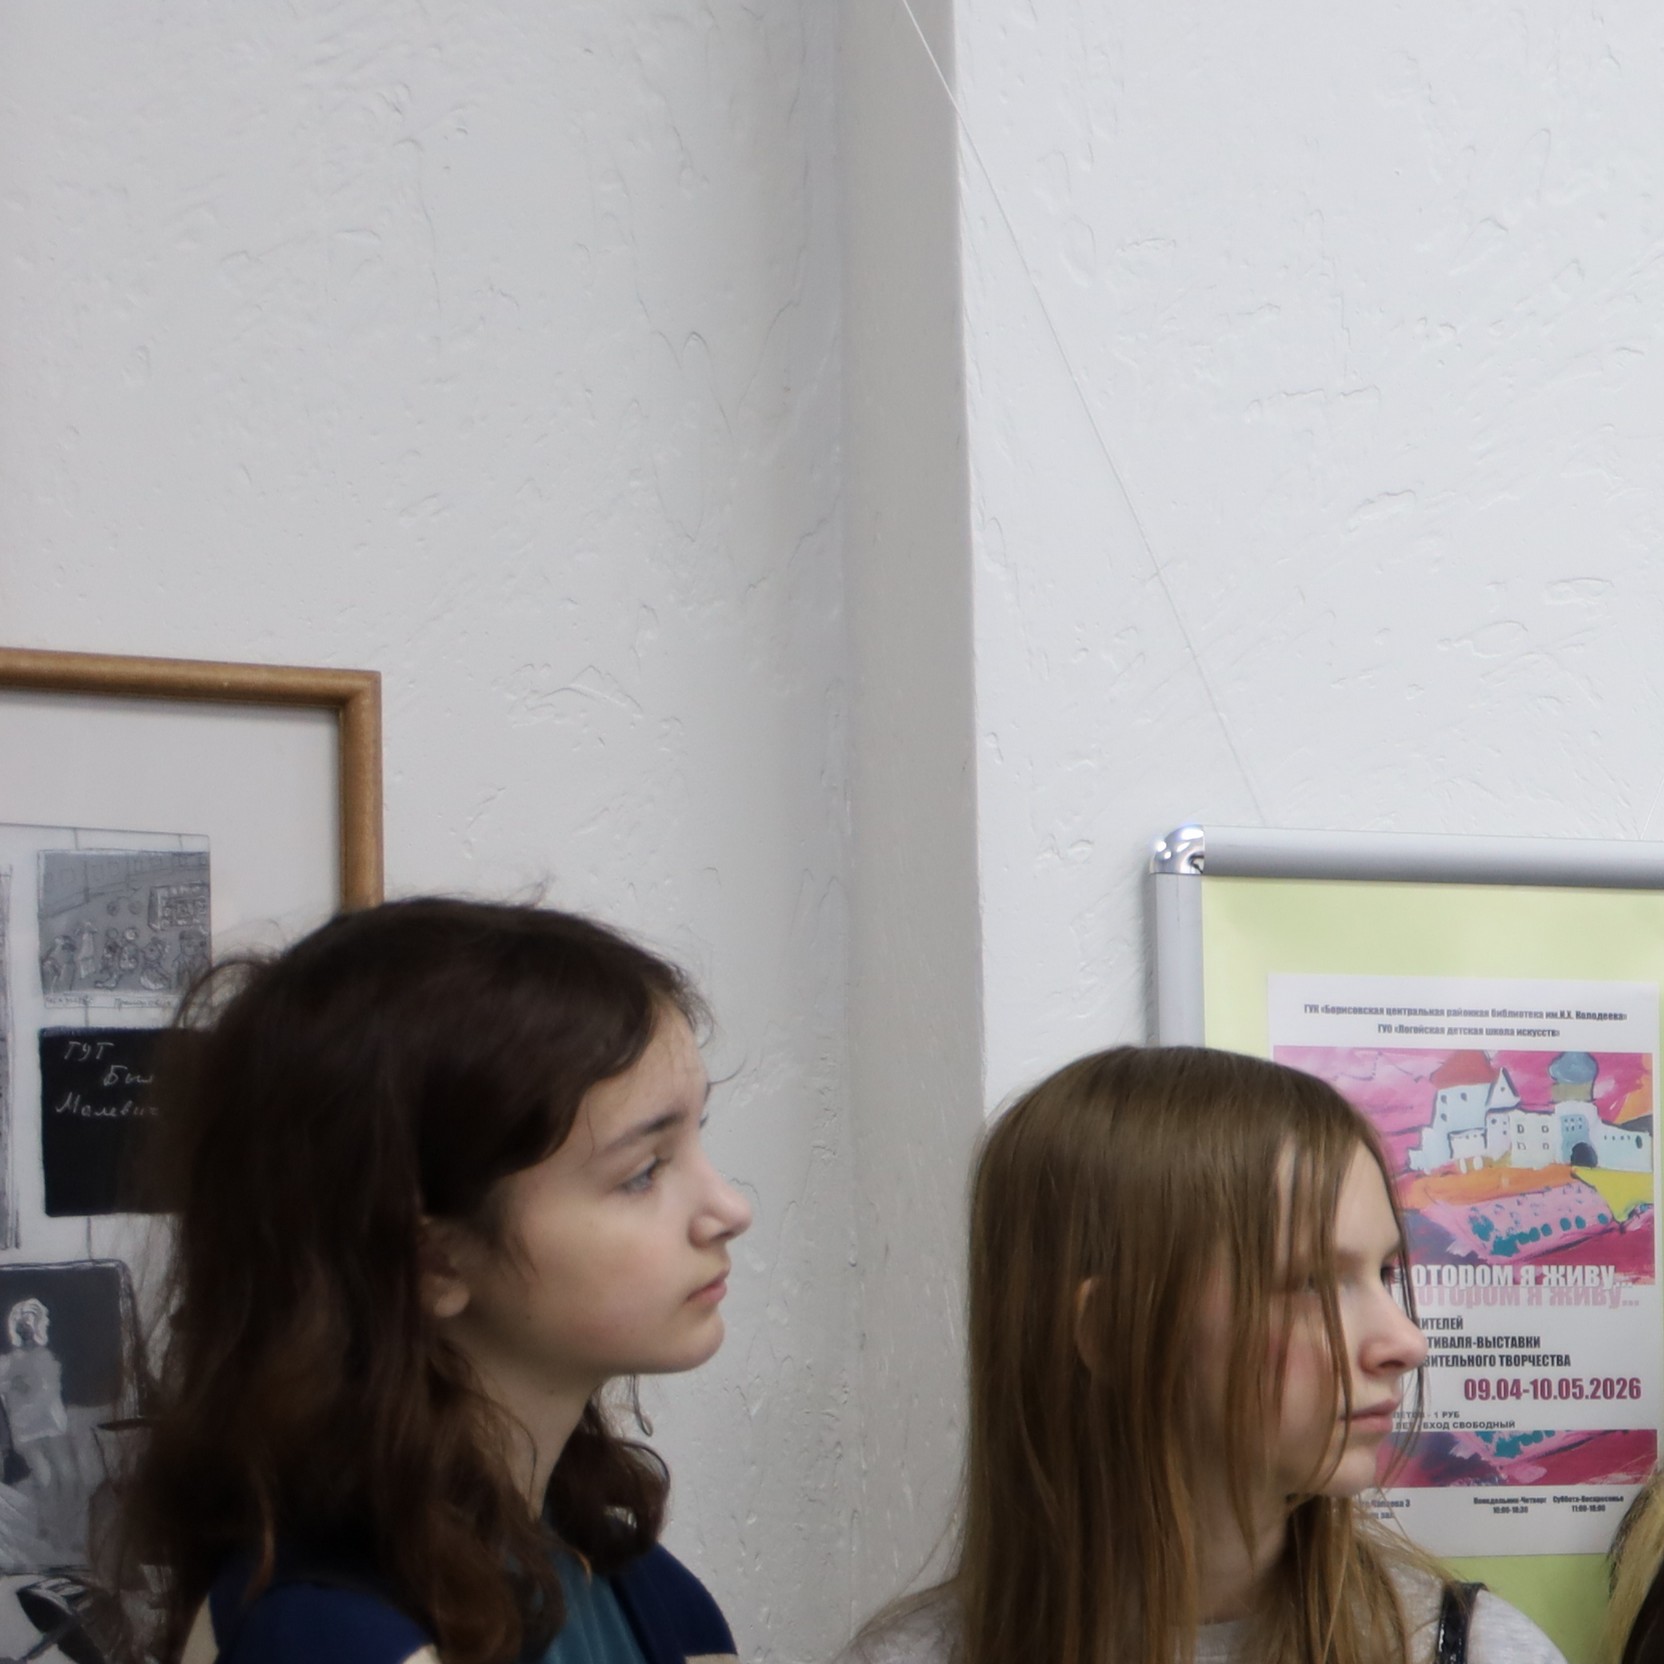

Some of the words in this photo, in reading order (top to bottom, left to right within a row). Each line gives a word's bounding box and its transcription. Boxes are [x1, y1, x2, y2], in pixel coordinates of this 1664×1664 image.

[1446, 1026, 1484, 1036] детская
[1485, 1027, 1515, 1036] школа
[1419, 1315, 1464, 1331] ИТЕЛЕЙ
[1427, 1336, 1541, 1349] ТИВАЛЯ-ВЫСТАВКИ
[1424, 1354, 1496, 1368] ЗИТЕЛЬНОГО
[1498, 1354, 1571, 1368] ТВОРЧЕСТВА
[1463, 1376, 1642, 1401] 09.04-10.05.2026
[1442, 1411, 1460, 1419] РУБ
[1422, 1421, 1450, 1431] ВХОД
[1452, 1419, 1516, 1430] СВОБОДНЫЙ
